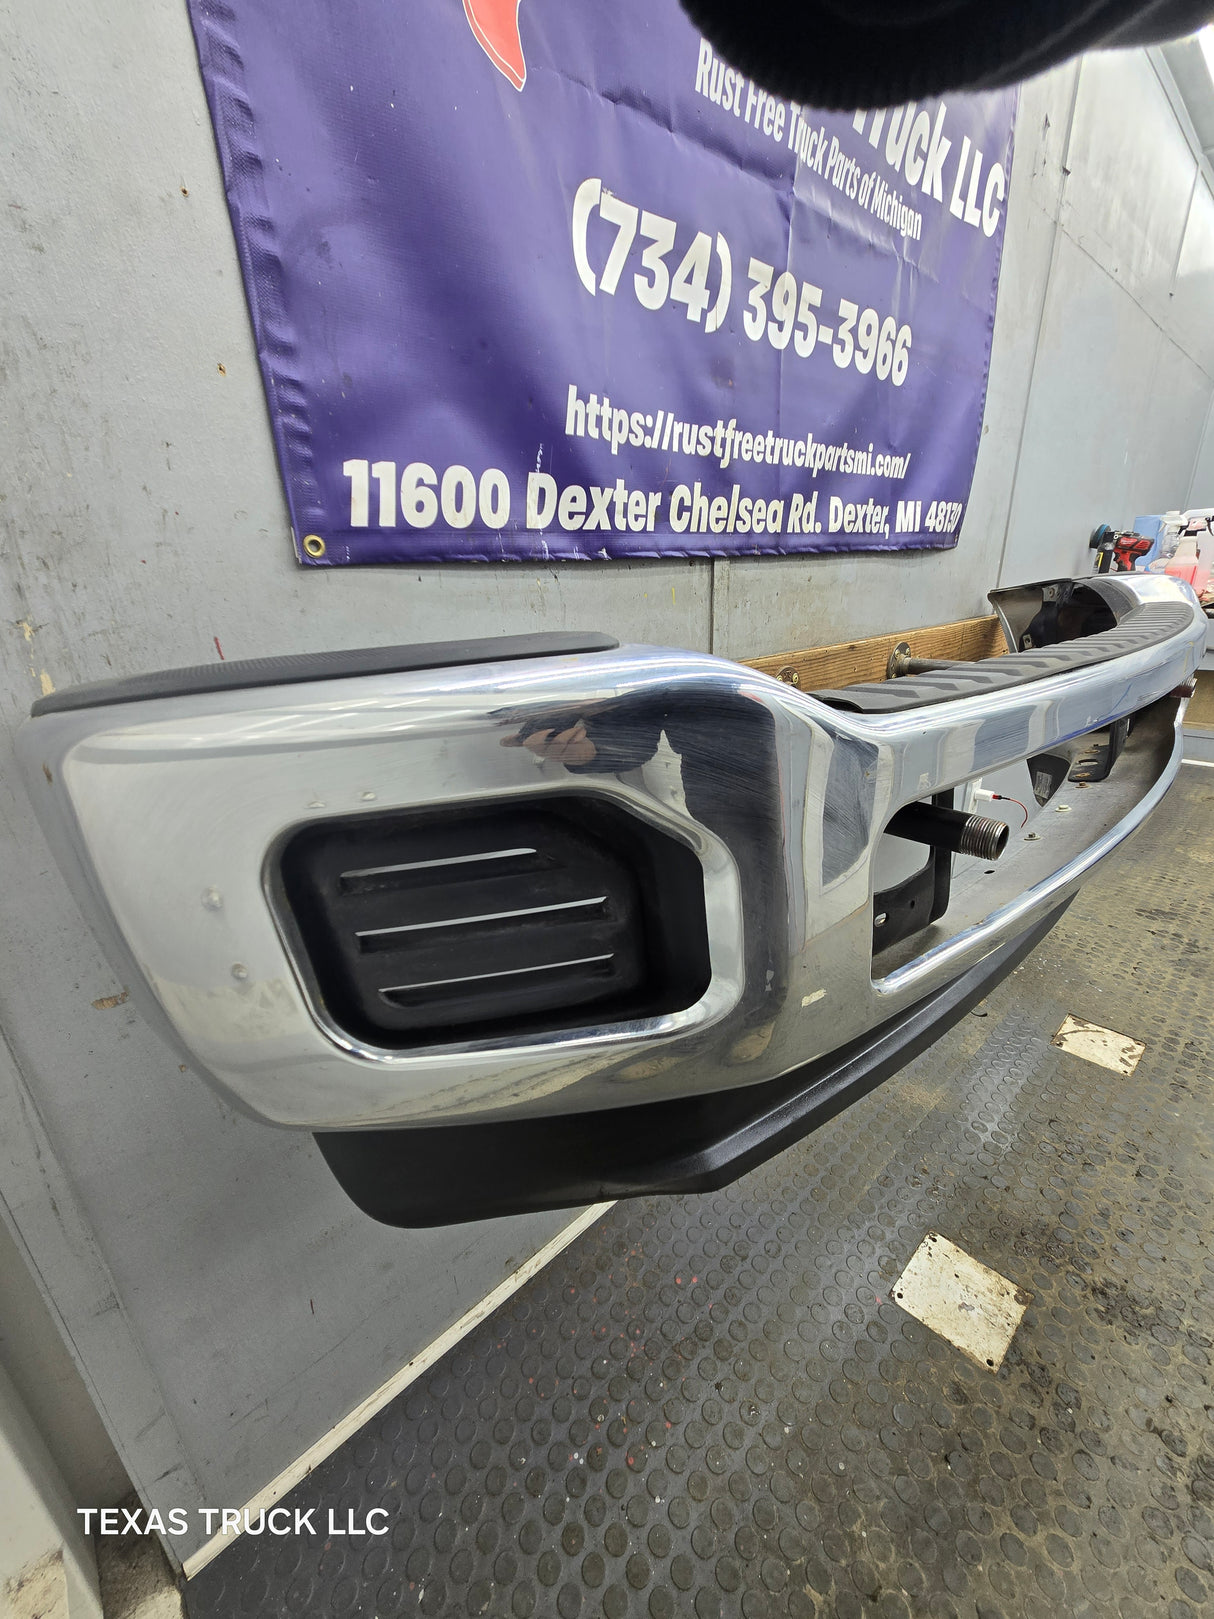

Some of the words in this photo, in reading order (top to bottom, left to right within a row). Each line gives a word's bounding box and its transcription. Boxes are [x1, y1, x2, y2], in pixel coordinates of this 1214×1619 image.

[695, 37, 745, 118] Rust
[788, 101, 829, 175] Truck
[824, 135, 861, 200] Parts
[858, 171, 878, 210] of
[870, 175, 923, 240] Michigan
[950, 136, 1005, 237] LLC
[572, 178, 732, 333] (734)
[743, 257, 912, 386] 395-3966
[565, 384, 911, 479] https://rustfreetruckpartsmi.com/
[343, 459, 511, 529] 11600
[526, 472, 662, 532] Dexter
[669, 482, 784, 534] Chelsea
[787, 491, 822, 533] Rd.
[828, 496, 889, 539] Dexter,
[895, 501, 922, 532] MI
[925, 501, 963, 533] 48130
